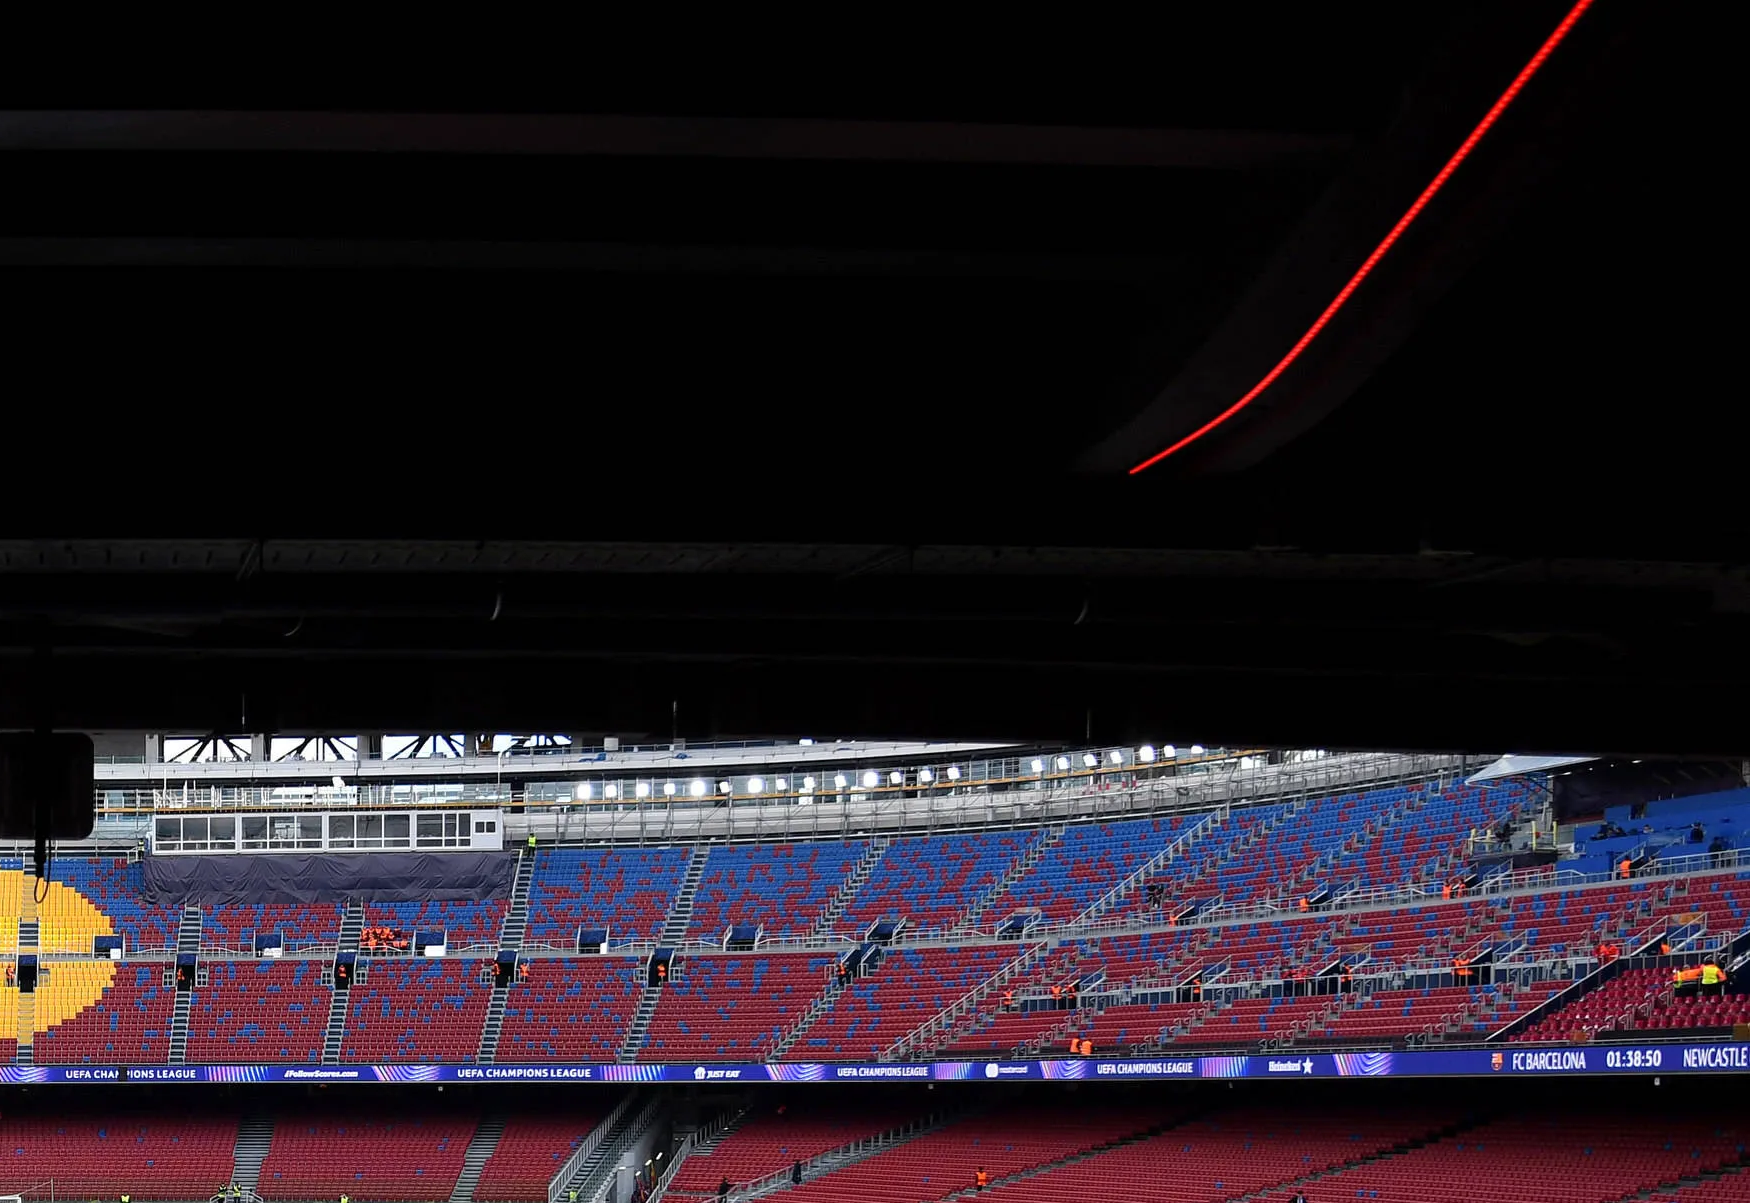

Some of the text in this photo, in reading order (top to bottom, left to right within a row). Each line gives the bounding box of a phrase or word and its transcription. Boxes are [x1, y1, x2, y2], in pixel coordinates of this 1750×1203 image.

[1512, 1051, 1587, 1071] FC BARCELONA
[1606, 1049, 1662, 1068] 01:38:50
[1683, 1046, 1748, 1068] NEWCASTLE
[65, 1070, 91, 1079] UEFA
[156, 1069, 196, 1079] LEAGUE
[457, 1068, 591, 1078] UEFA CHAMPIONS LEAGUE
[837, 1067, 929, 1077] UEFA CHAMPIONS LEAGUE
[1097, 1062, 1194, 1075] UEFA CHAMPIONS LEAGUE
[706, 1070, 741, 1079] JUST EAT
